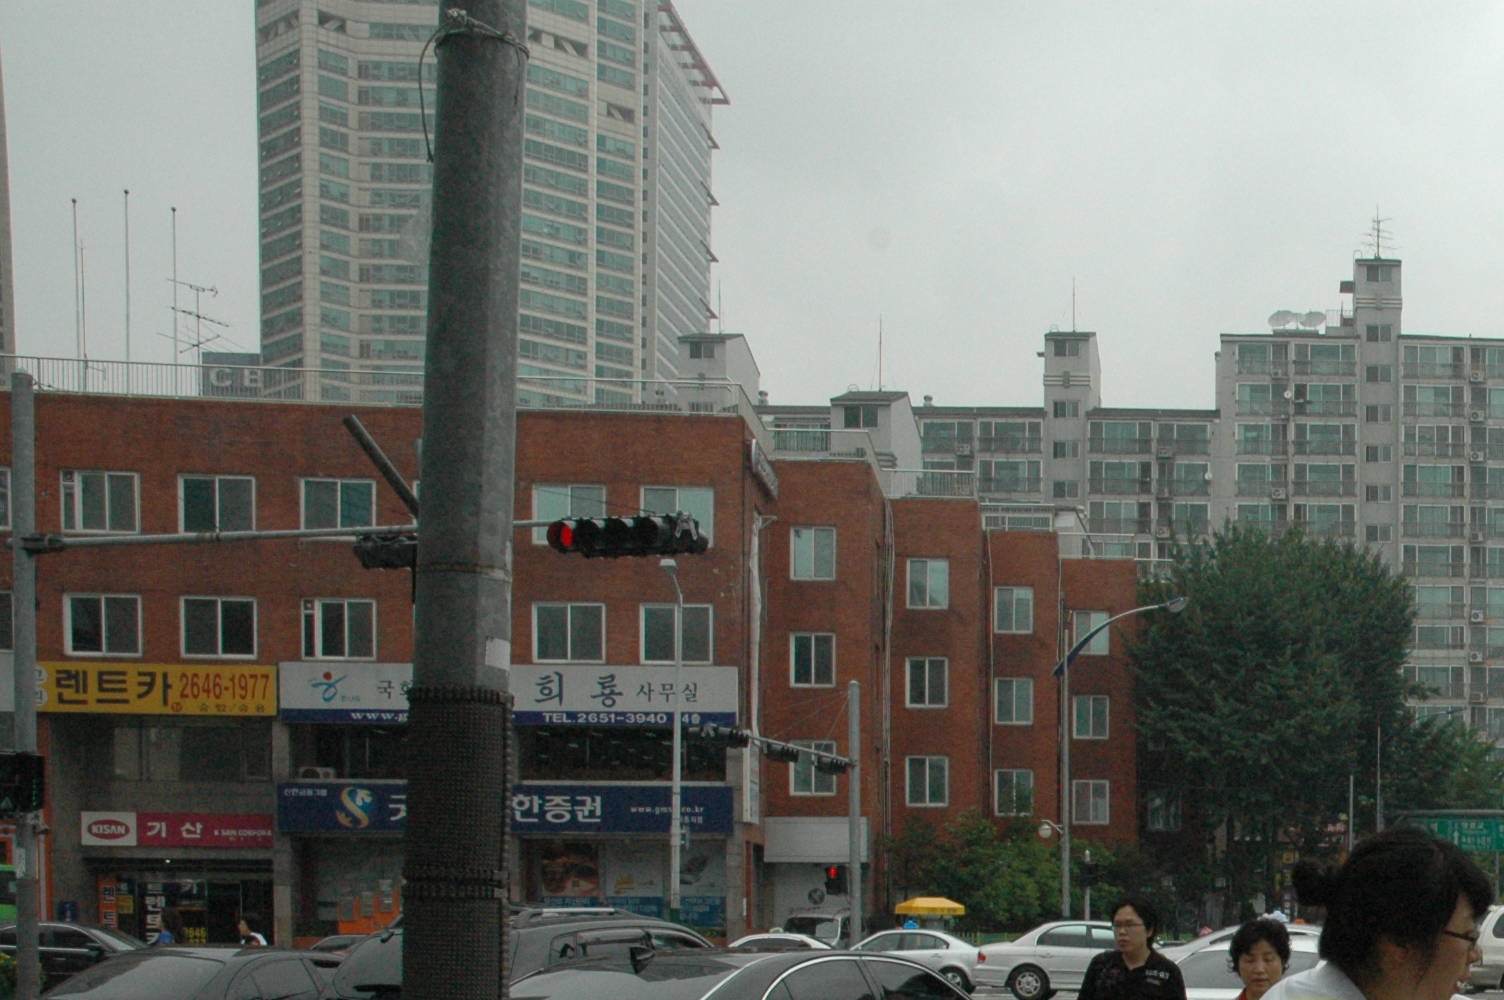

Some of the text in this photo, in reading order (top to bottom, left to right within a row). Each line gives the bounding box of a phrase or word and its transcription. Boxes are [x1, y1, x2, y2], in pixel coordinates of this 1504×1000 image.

[55, 669, 172, 706] 렌트카
[179, 673, 270, 700] 2646-1977
[636, 681, 698, 703] 사무실
[91, 823, 127, 834] KISAN
